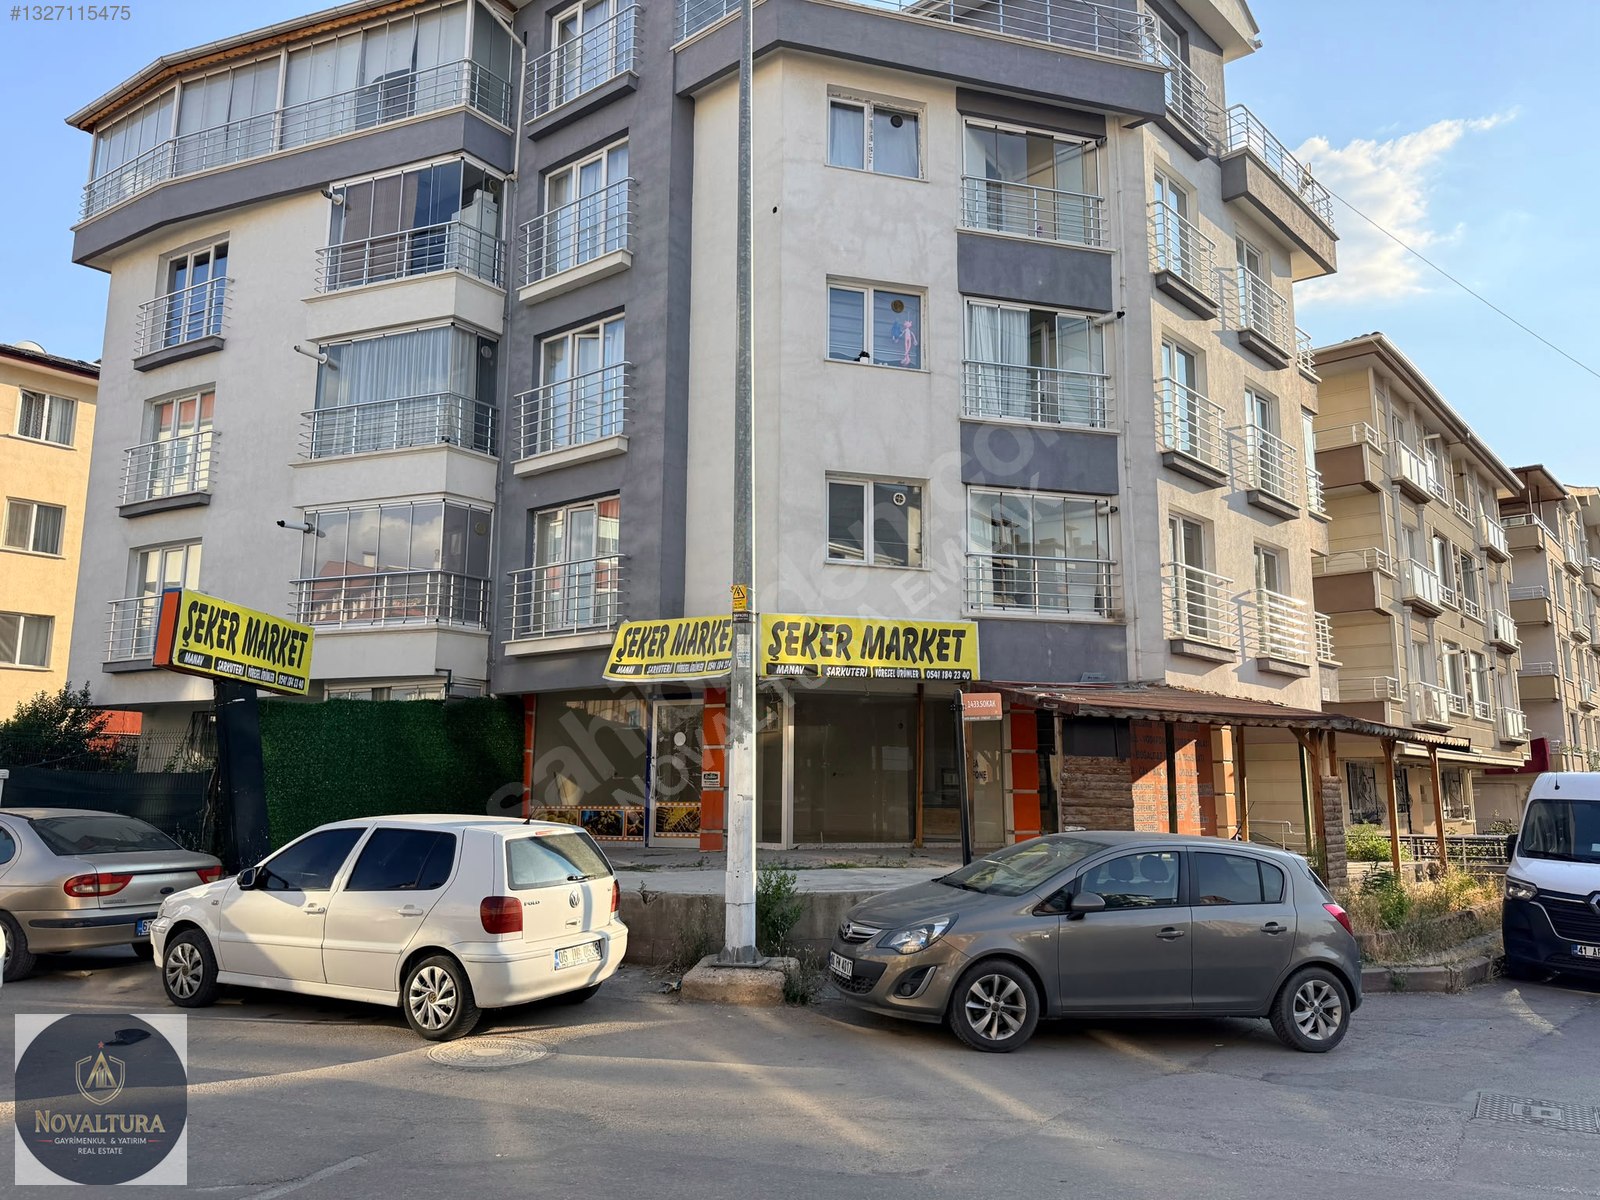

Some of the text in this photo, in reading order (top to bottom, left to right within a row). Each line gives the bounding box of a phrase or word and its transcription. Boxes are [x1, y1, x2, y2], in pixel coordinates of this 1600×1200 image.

[182, 600, 308, 669] ŞEKER MARKET
[616, 624, 670, 662] ŞEKER
[670, 619, 732, 657] MARKE
[768, 621, 853, 661] ŞEKER
[860, 625, 966, 664] MARKET
[184, 652, 205, 666] MANAV
[615, 665, 636, 674] MANAV
[776, 665, 805, 675] MANAV
[875, 667, 896, 678] YÖRESEL
[926, 670, 970, 680] 0541 184 23 40
[1578, 946, 1587, 955] 41
